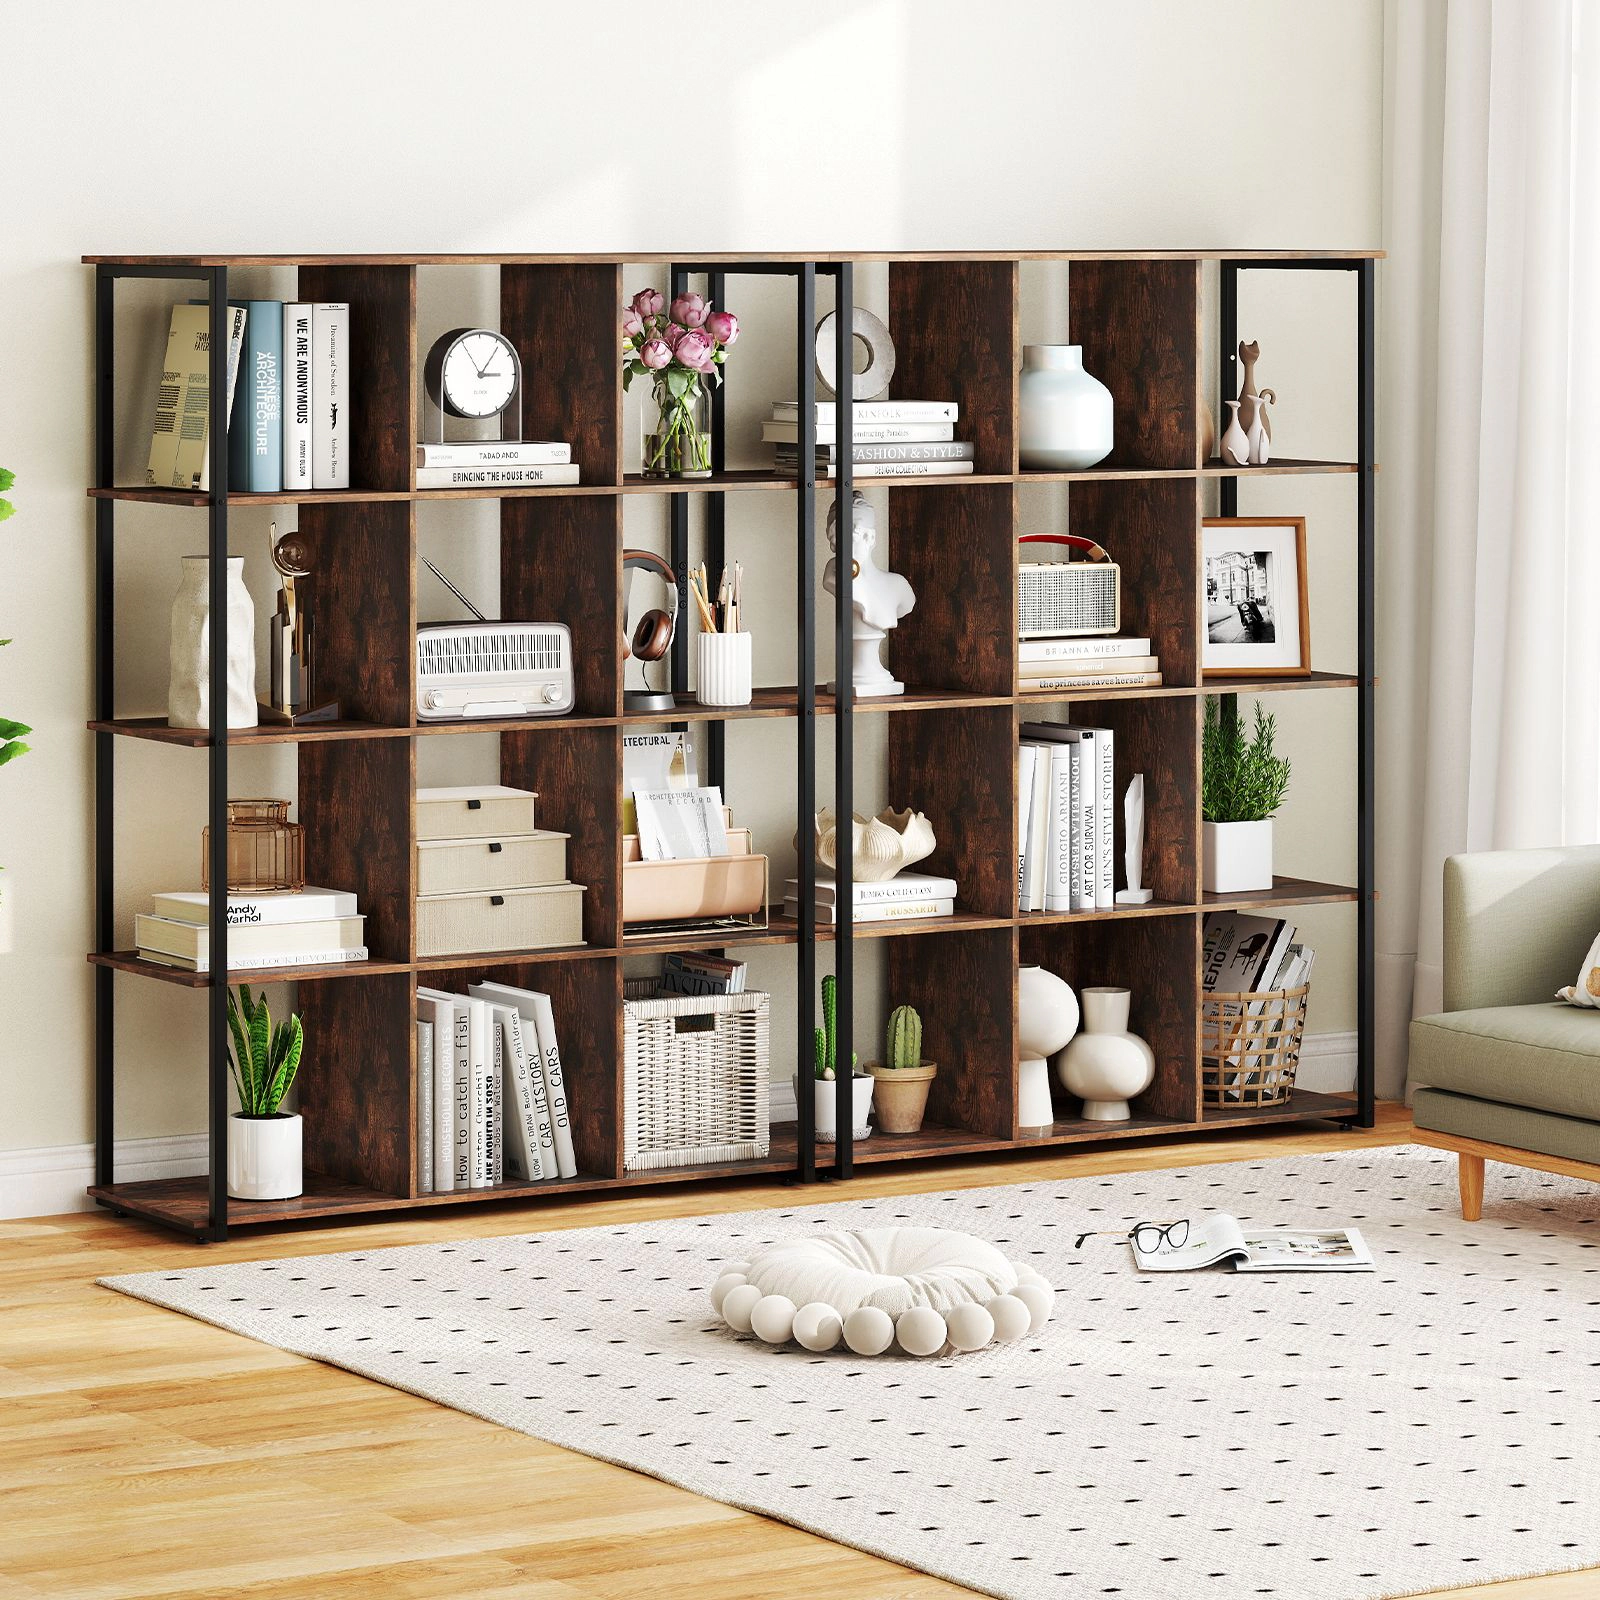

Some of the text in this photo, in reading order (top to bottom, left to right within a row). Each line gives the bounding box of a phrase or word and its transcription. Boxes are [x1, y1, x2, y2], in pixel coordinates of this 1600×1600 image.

[329, 325, 337, 359] Dreaming
[297, 318, 307, 423] WE ARE ANONYMOUS
[266, 352, 276, 420] JAPANESE
[256, 352, 267, 455] ARCHITECTURE
[858, 408, 901, 418] KINFOLK
[501, 451, 519, 459] ANDO
[911, 448, 920, 458] &
[924, 446, 963, 458] STYLE
[875, 464, 928, 474] DESIGN COLLECTION
[453, 472, 485, 482] BRINGING
[487, 471, 499, 481] THE
[501, 471, 523, 480] HOUSE
[1046, 645, 1122, 656] BRIANNA WIEST
[1039, 675, 1144, 690] the princess saves herself
[1103, 744, 1112, 889] MEN'S STYLE STORIES
[1085, 804, 1093, 897] ART FOR SURVIVAL
[227, 904, 257, 915] Andy
[884, 904, 938, 916] TRUSSARDI
[235, 958, 259, 967] NEW
[262, 956, 292, 965] LOOK
[546, 1046, 567, 1127] OLD CARS
[442, 1027, 451, 1162] HOUSEHOLD DECORATES
[456, 1015, 467, 1181] How to catch a fish
[511, 1013, 541, 1176] HOW TO DRAW Book for children
[528, 1053, 552, 1148] CAR HISTORY
[494, 1112, 501, 1122] by
[425, 1128, 430, 1137] an
[424, 1161, 430, 1169] to
